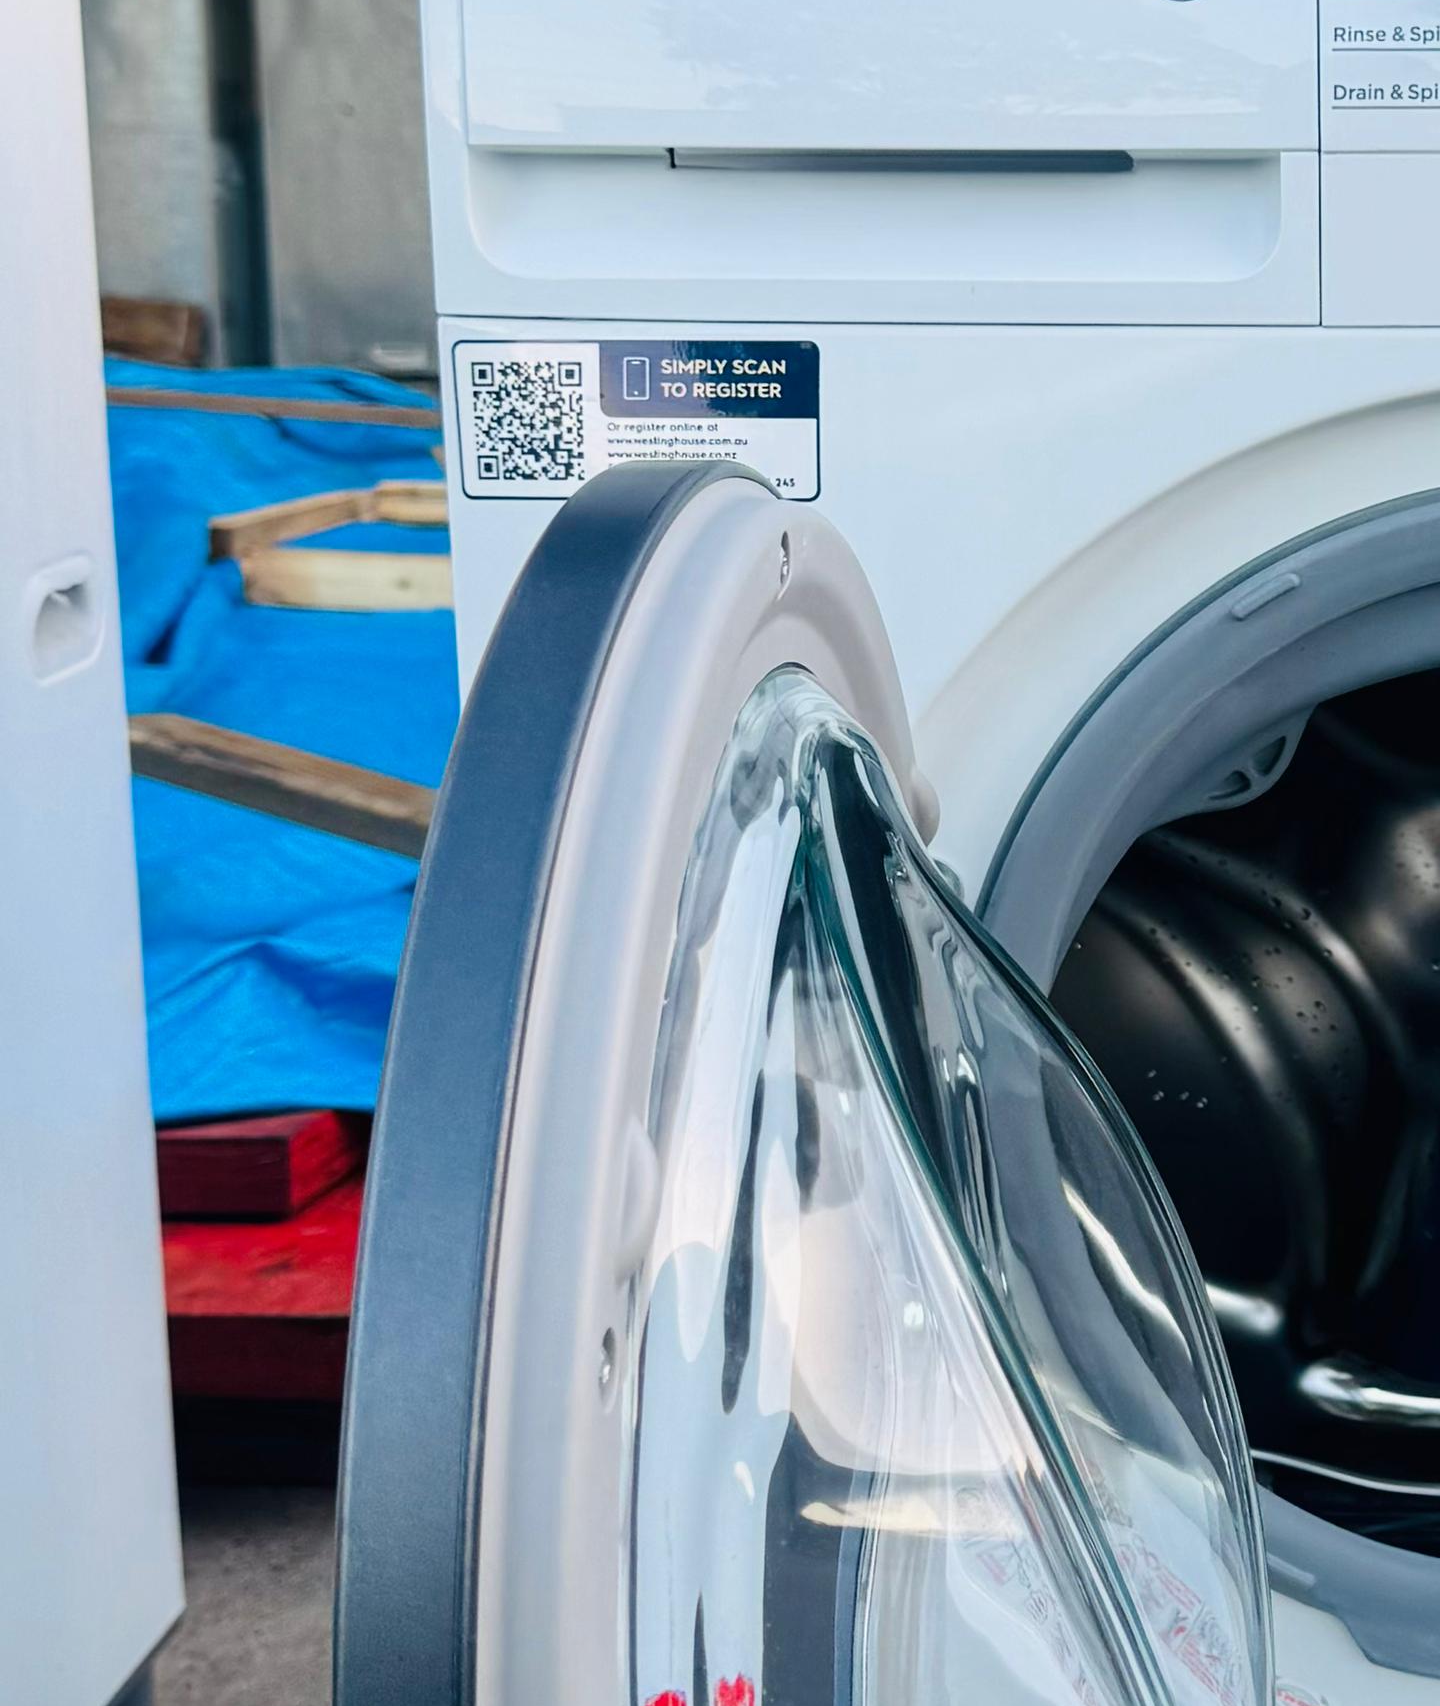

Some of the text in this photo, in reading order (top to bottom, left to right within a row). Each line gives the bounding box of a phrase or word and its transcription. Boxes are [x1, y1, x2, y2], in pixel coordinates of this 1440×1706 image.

[1333, 26, 1387, 43] Rinse
[1392, 26, 1406, 43] &
[1333, 83, 1385, 101] Drain
[1390, 84, 1404, 101] &
[660, 358, 787, 375] SIMPLY SCAN
[660, 381, 782, 399] TO REGISTER
[607, 421, 719, 434] Or register online at
[607, 436, 749, 448] www.westinghouse.com.au
